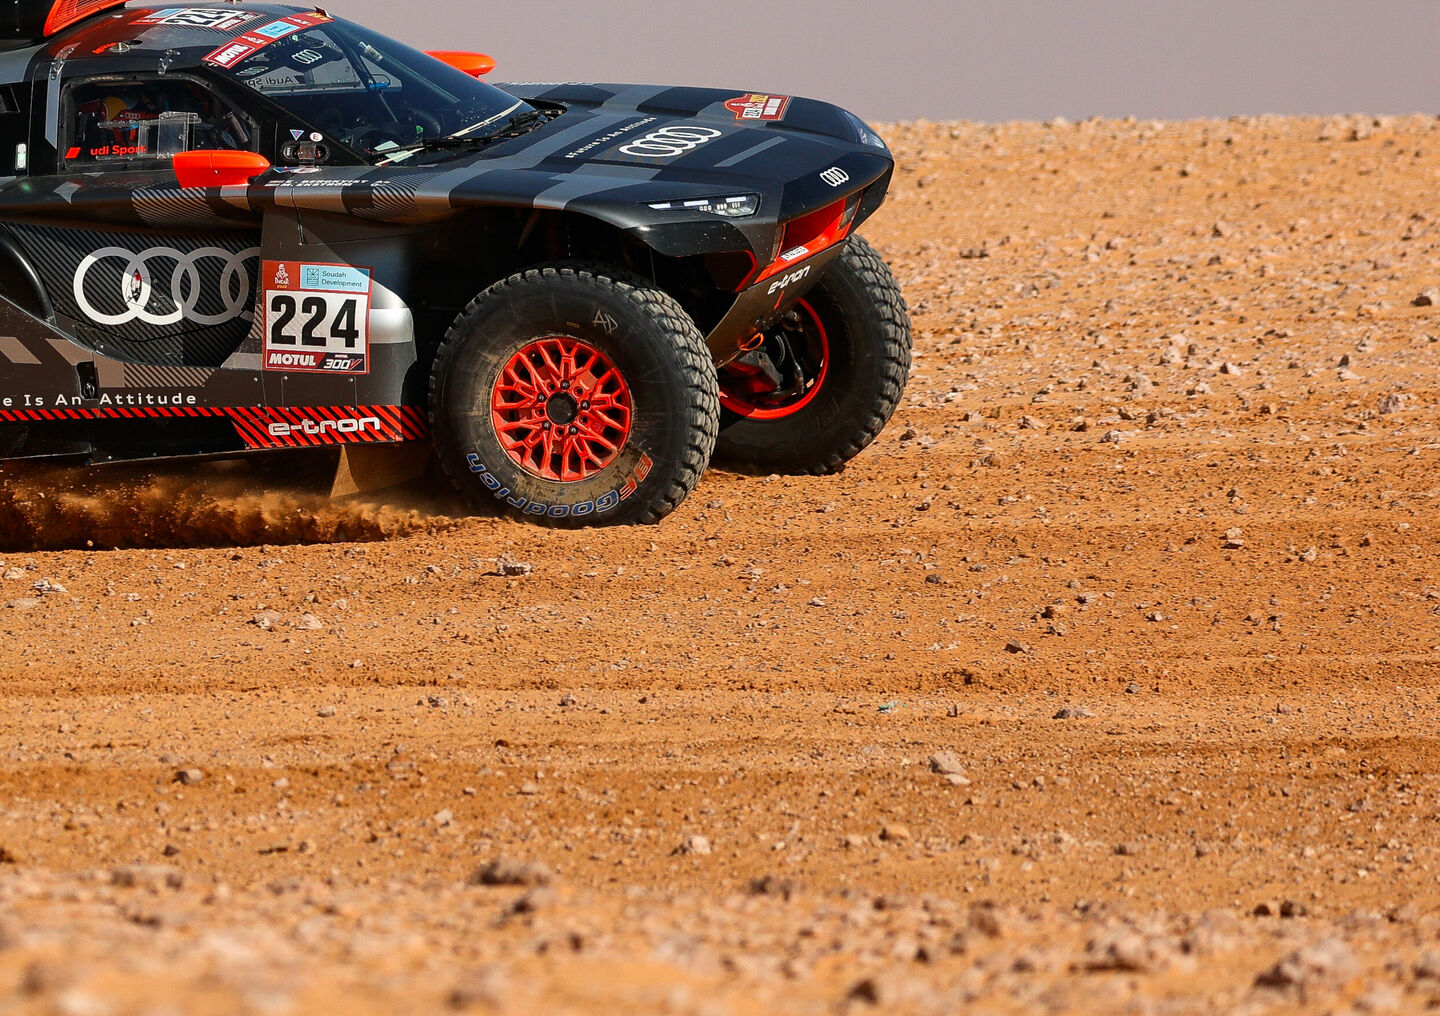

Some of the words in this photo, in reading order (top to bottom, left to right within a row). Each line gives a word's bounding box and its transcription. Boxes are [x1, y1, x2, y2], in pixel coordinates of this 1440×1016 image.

[214, 44, 249, 65] MOTUL
[90, 145, 110, 156] udi
[112, 144, 146, 156] Sport
[321, 279, 362, 288] Development
[767, 265, 811, 295] e-tron
[271, 295, 359, 348] 224
[592, 308, 619, 336] AD
[268, 353, 317, 367] MOTUL
[323, 358, 363, 371] 300V
[24, 394, 44, 407] Is
[55, 393, 83, 406] An
[99, 392, 197, 406] Attitude
[267, 416, 381, 436] e-tron
[465, 451, 654, 518] BFGoodrich
